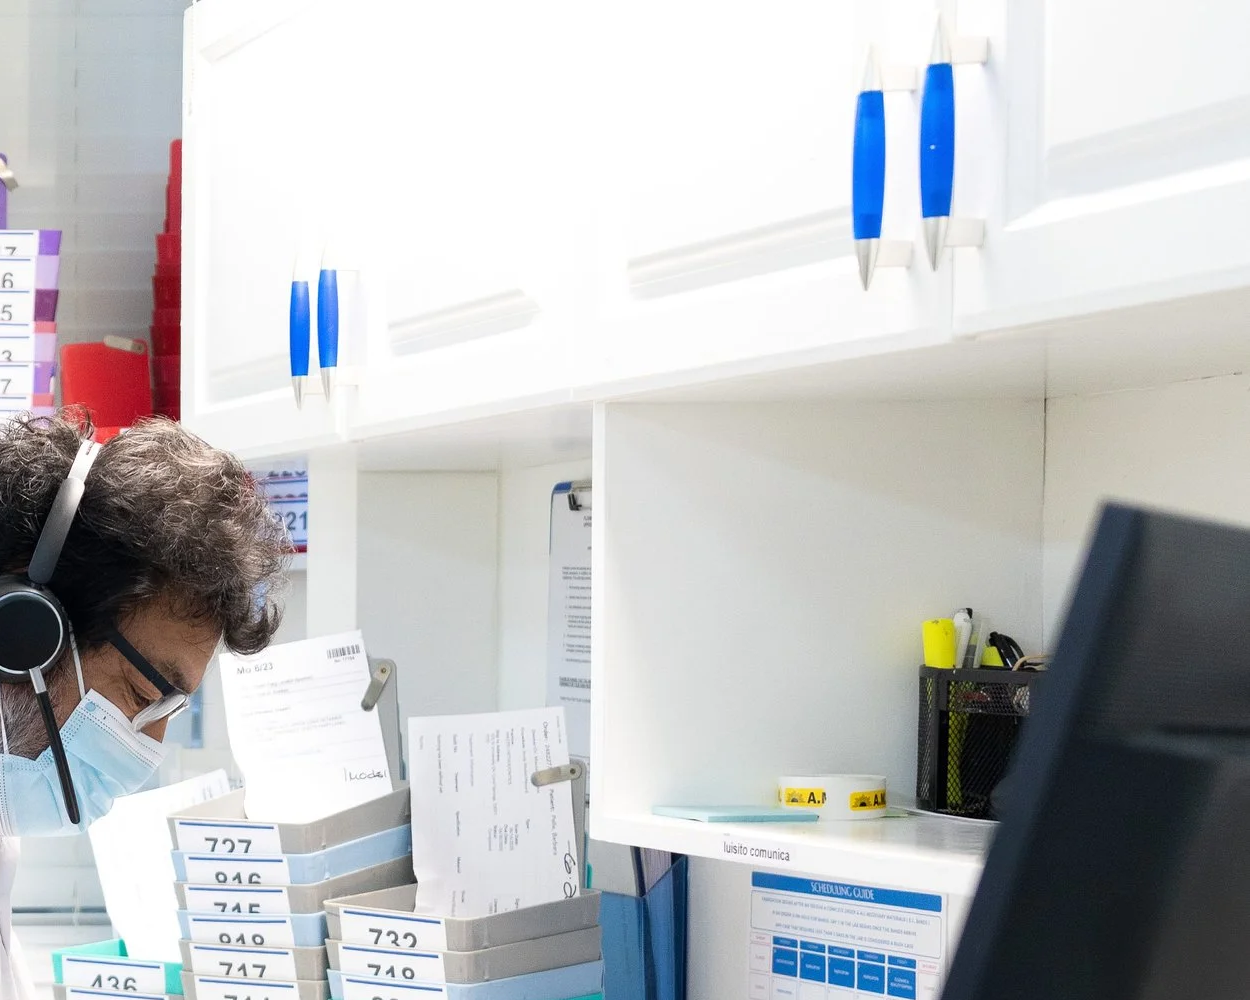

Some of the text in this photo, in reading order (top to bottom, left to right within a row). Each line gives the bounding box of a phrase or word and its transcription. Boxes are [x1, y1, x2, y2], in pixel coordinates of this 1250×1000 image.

[723, 841, 790, 862] luisito comunica
[810, 881, 875, 900] SCHEDULING GUIDE
